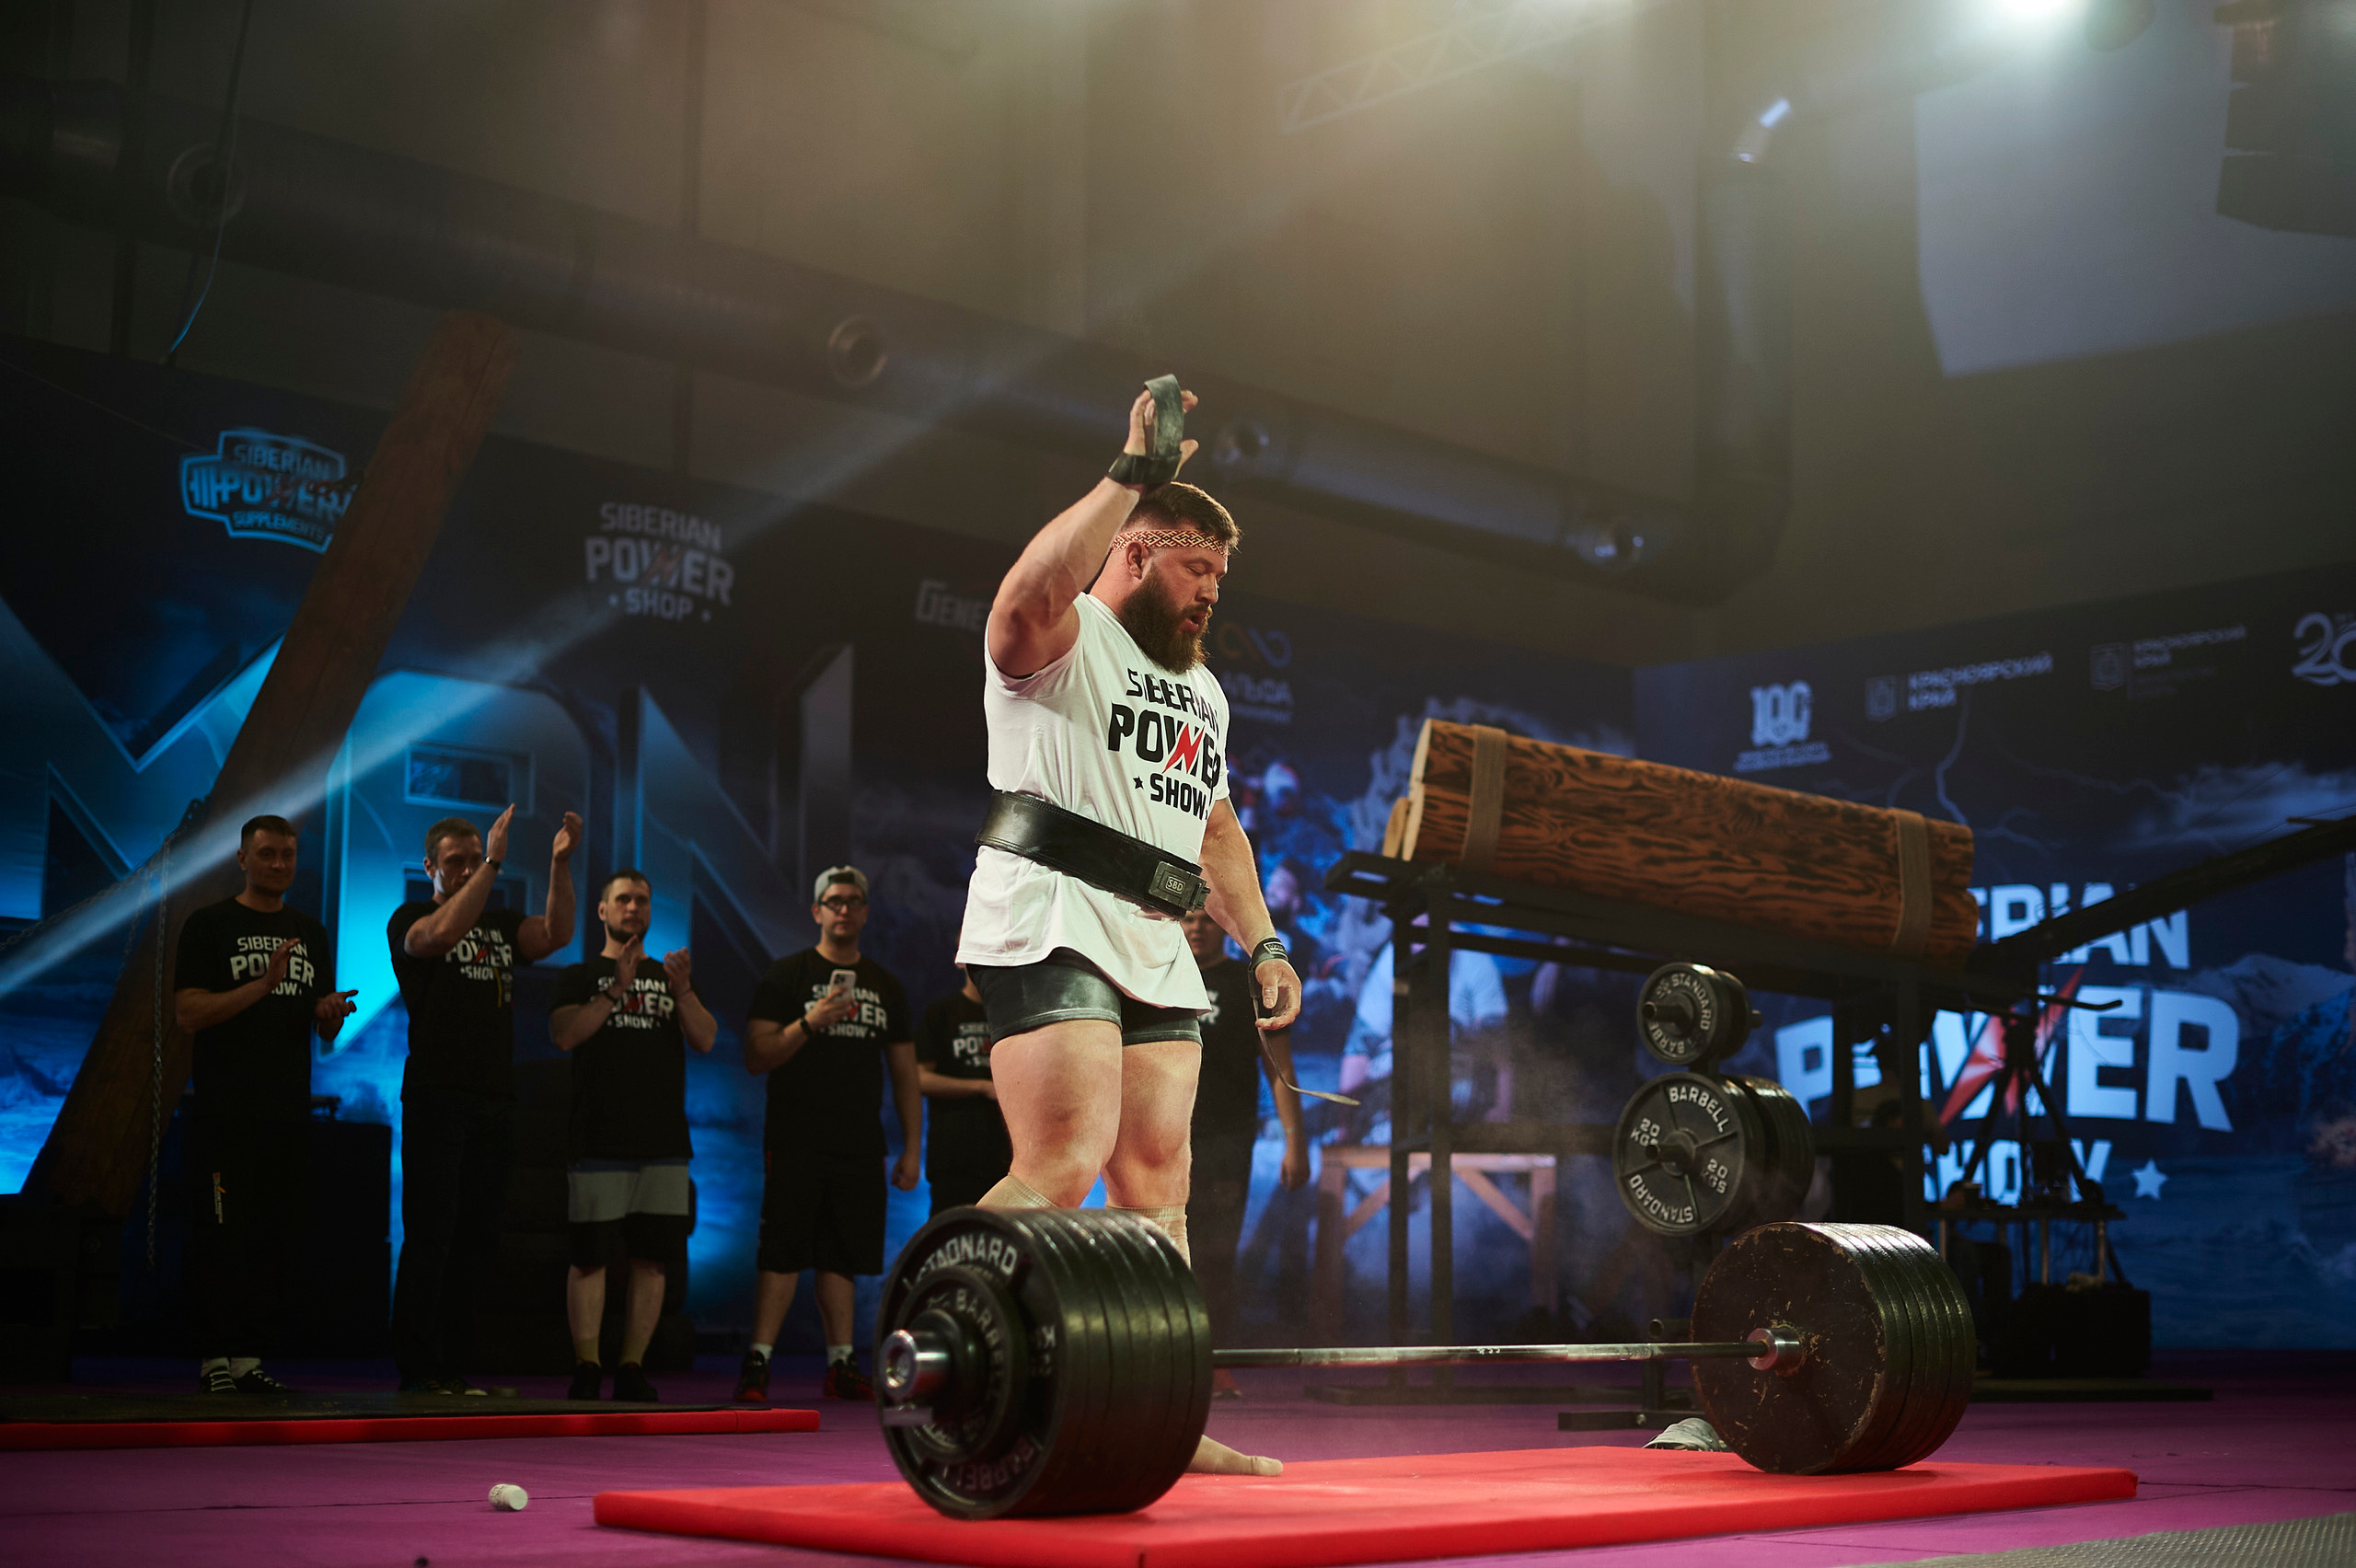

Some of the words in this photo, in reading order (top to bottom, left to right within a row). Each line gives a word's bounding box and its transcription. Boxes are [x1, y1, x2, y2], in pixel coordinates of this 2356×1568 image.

[233, 444, 330, 480] SIBERIAN
[600, 502, 722, 552] SIBERIAN
[585, 536, 734, 605] POWER
[625, 586, 694, 623] SHOP
[1150, 773, 1207, 821] SHOW
[1167, 879, 1184, 892] SBD
[237, 935, 309, 959] SIBERAN
[229, 952, 315, 988] POER
[1670, 973, 1712, 1031] STANDARD
[614, 1013, 654, 1030] SHOW
[827, 1022, 868, 1039] SHOW
[1640, 1117, 1661, 1137] 20
[1669, 1086, 1729, 1134] BARBELL
[1706, 1158, 1728, 1180] 20
[1628, 1173, 1694, 1224] STANDARD
